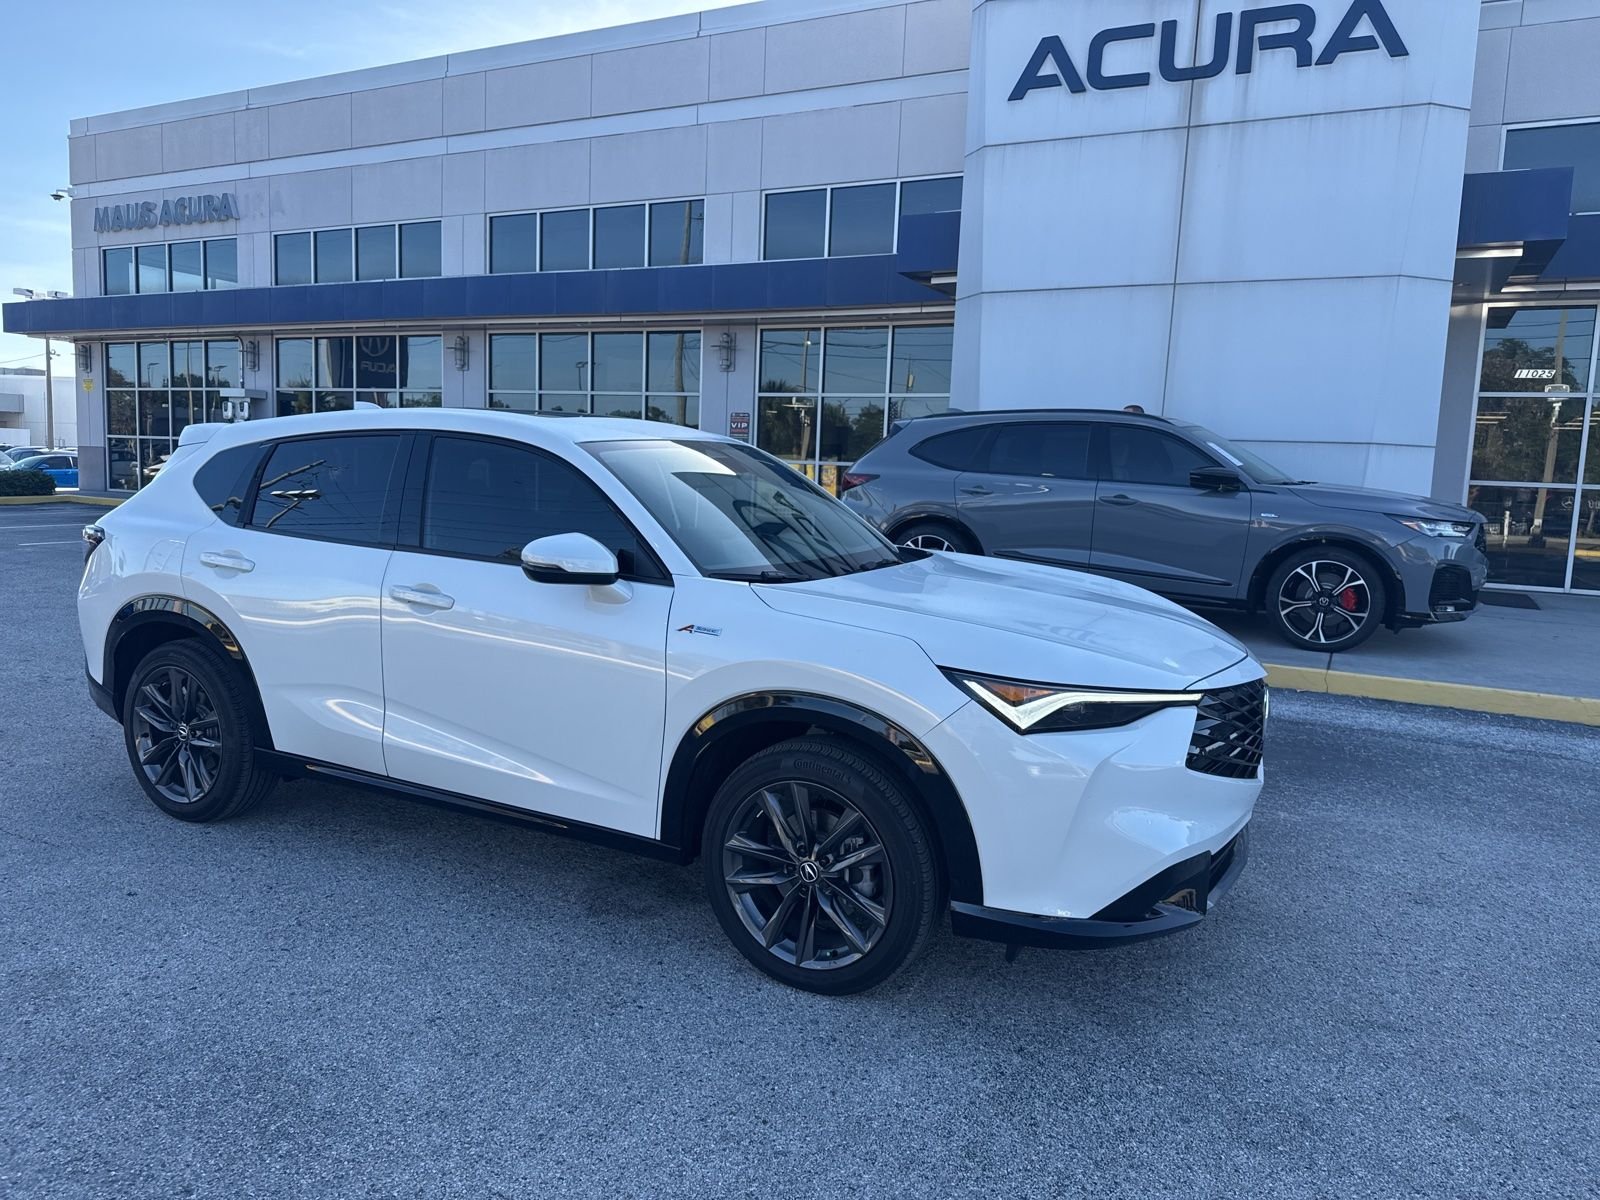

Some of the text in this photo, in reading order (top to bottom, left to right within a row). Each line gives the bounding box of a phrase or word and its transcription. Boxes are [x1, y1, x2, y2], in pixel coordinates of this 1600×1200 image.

[1007, 0, 1409, 101] ACURA
[94, 192, 240, 233] MAUS ACURA
[1516, 369, 1554, 378] 11025
